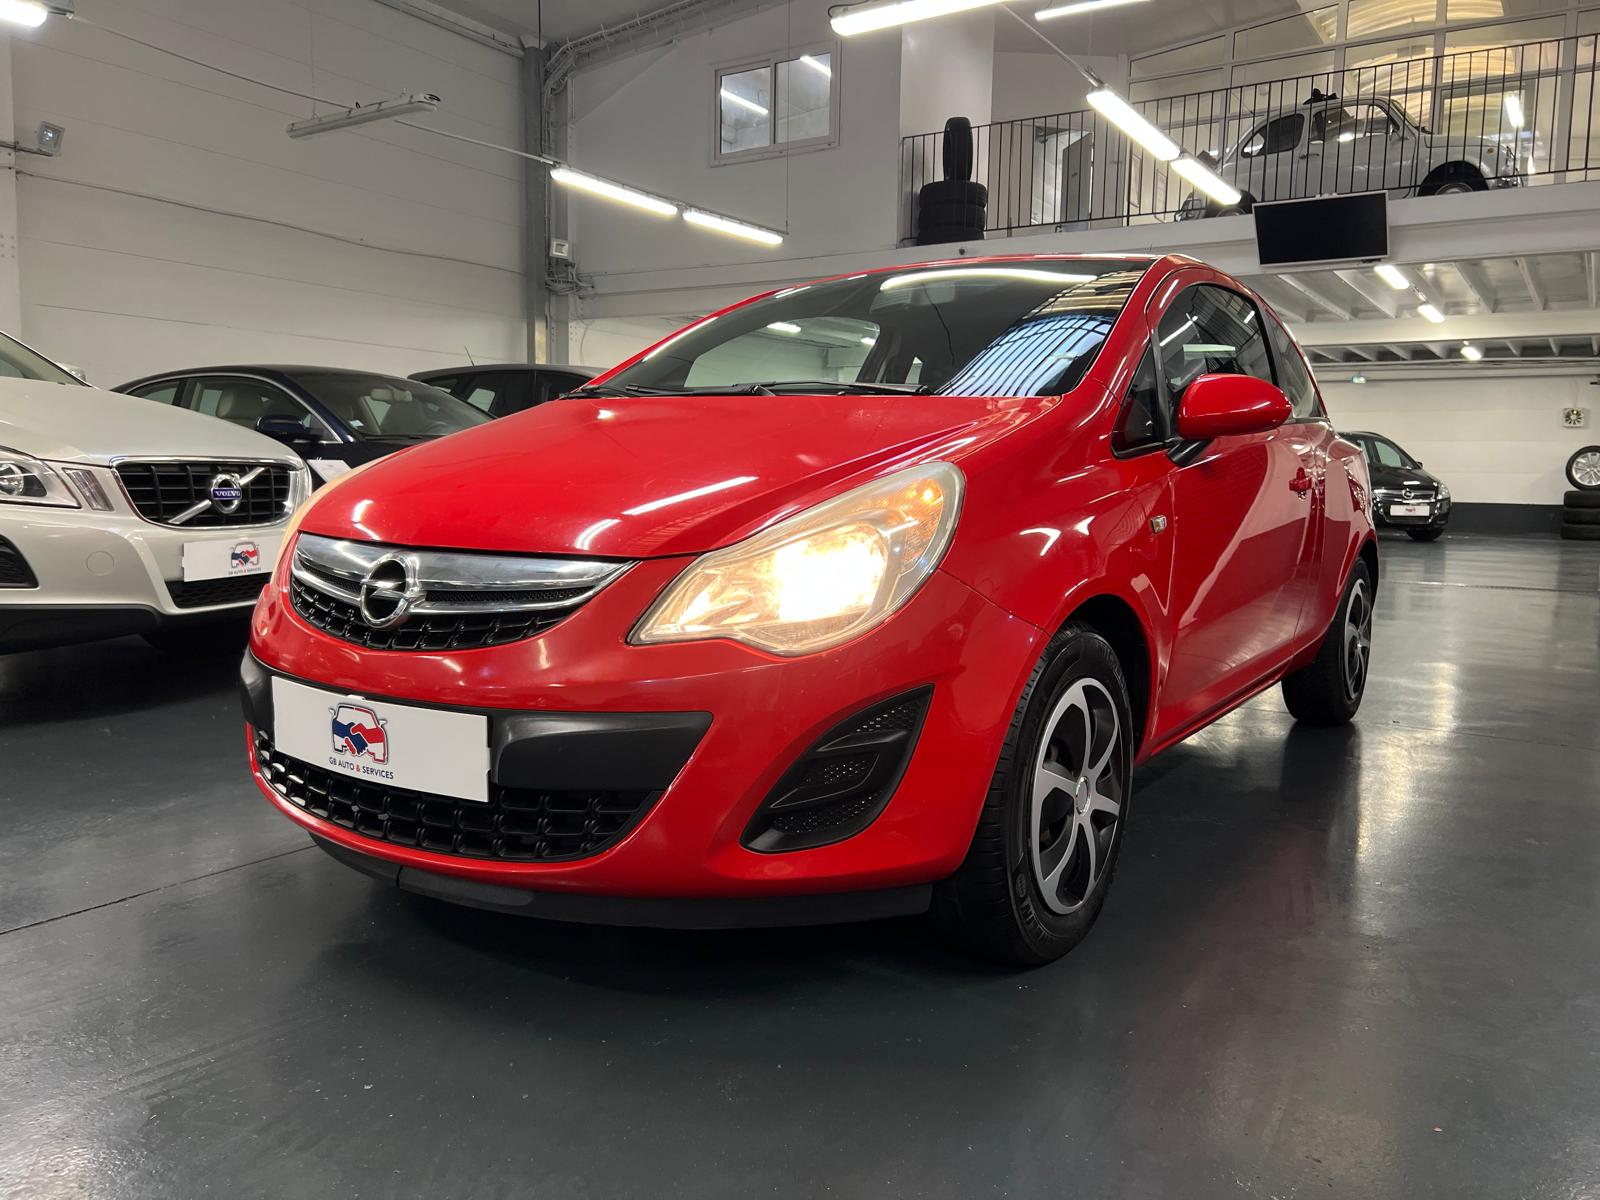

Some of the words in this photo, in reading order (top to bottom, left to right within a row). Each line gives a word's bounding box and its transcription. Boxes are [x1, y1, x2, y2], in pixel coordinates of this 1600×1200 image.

[329, 757, 337, 765] GB
[338, 760, 354, 770] AUTO
[356, 764, 361, 772] &
[362, 766, 394, 779] SERVICES
